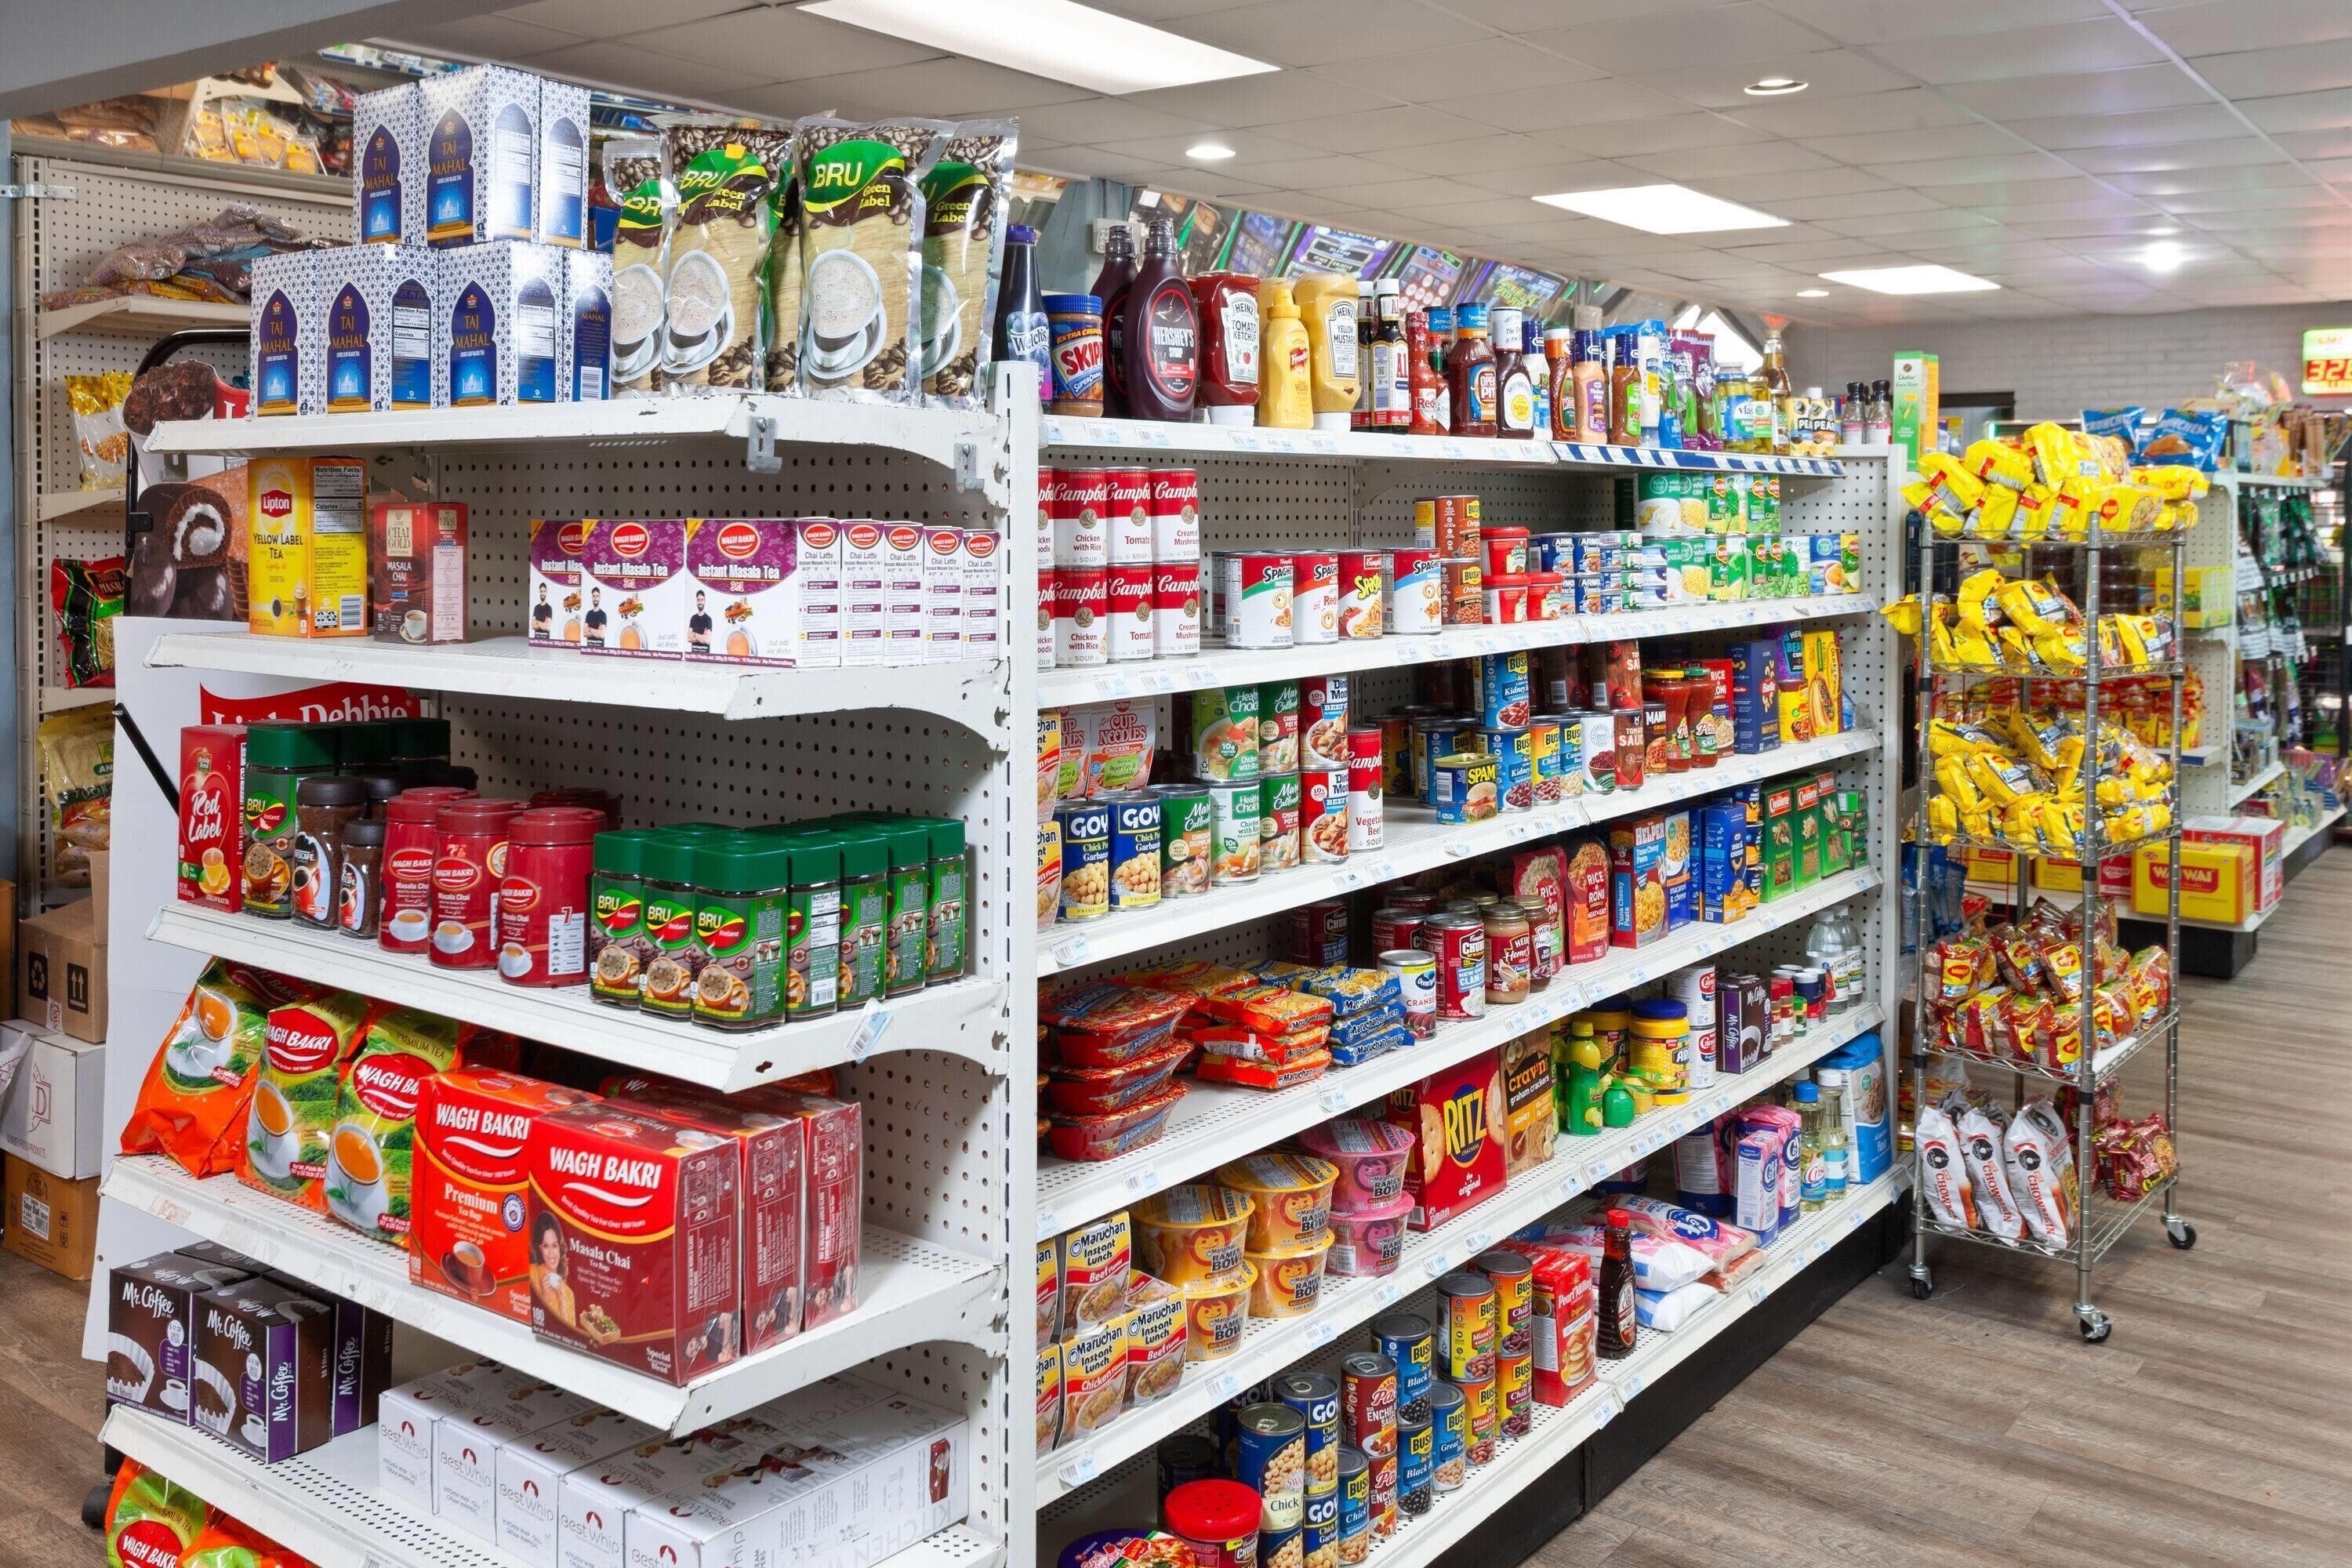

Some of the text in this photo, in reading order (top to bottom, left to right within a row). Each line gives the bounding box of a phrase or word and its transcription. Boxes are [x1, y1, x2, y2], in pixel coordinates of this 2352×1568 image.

[441, 142, 456, 156] TAJ
[372, 157, 387, 172] TAJ
[433, 158, 467, 175] MAHAL
[366, 174, 395, 191] MAHAL
[813, 162, 862, 188] BRU
[862, 183, 891, 195] Green
[858, 195, 891, 209] Label
[935, 201, 971, 212] Green
[1236, 303, 1254, 315] HEINZ
[1337, 307, 1353, 317] HEINZ
[1232, 320, 1256, 330] TOMATO
[1338, 325, 1353, 334] YELLOW
[1012, 325, 1048, 352] Welch's
[1057, 331, 1080, 343] EXTRA
[1153, 327, 1193, 348] HERSHEY'S
[1233, 330, 1256, 342] KETCHUP
[1334, 335, 1356, 344] MUSTARD
[262, 338, 292, 354] MAHAL
[1169, 348, 1182, 358] SYRUP
[263, 497, 289, 510] Lipton
[253, 533, 303, 546] YELLOW LABEL
[388, 527, 409, 539] CHAI
[388, 539, 411, 549] GOLD
[270, 548, 283, 559] TEA
[387, 561, 412, 572] MASALA
[594, 563, 667, 575] Instant Masala Tea
[699, 564, 779, 579] Instant Masala Tea
[393, 572, 406, 581] CHAI
[1711, 670, 1726, 681] RICE
[1504, 685, 1526, 695] Kidney
[1762, 681, 1775, 692] Barilla
[299, 695, 408, 722] Debbie
[1109, 714, 1137, 729] CUP
[1099, 726, 1146, 745] NOODLES
[1542, 757, 1556, 765] Chili
[1468, 764, 1496, 785] SPAM
[191, 790, 220, 816] Red
[247, 798, 266, 812] BRU
[189, 815, 222, 842] Label
[1367, 826, 1381, 835] Beef
[1635, 826, 1665, 845] HELPER
[1135, 833, 1149, 842] Chick
[1083, 843, 1096, 851] Chick
[1588, 872, 1604, 885] RICE
[2183, 869, 2212, 883] WAI
[1589, 889, 1605, 903] RONI
[699, 912, 722, 928] BRU
[1460, 975, 1479, 986] CLAM
[289, 1031, 332, 1051] BAKRI
[1133, 1021, 1172, 1050] Yakisoba
[397, 1031, 445, 1060] PREMIUM TEA
[358, 1064, 399, 1092] WAGH
[1508, 1059, 1546, 1091] crav'n
[1510, 1075, 1549, 1106] graham crackers
[437, 1103, 531, 1140] WAGH BAKRI
[1443, 1088, 1486, 1155] RITZ
[1514, 1113, 1530, 1126] HONEY
[1461, 1145, 1479, 1156] CRACKERS
[550, 1147, 662, 1189] WAGH BAKRI
[1458, 1175, 1480, 1196] original
[1981, 1164, 2013, 1222] CHOWMEIN
[445, 1183, 498, 1214] Premium
[2027, 1174, 2058, 1236] CHOWMEIN
[561, 1196, 574, 1208] Best
[575, 1206, 590, 1220] Quality
[1080, 1221, 1127, 1250] Maruchan
[570, 1238, 630, 1269] Masala Chai
[1083, 1240, 1116, 1259] Instant
[1087, 1250, 1112, 1267] Lunch
[1089, 1268, 1109, 1283] Beef
[122, 1282, 174, 1318] Mr. Coffee
[1558, 1279, 1592, 1308] Pearl Milling
[532, 1307, 544, 1321] 100
[1138, 1300, 1182, 1330] Maruchan
[1570, 1305, 1586, 1317] Original
[208, 1310, 252, 1349] Mr. Coffee
[1141, 1319, 1172, 1338] Instant
[1472, 1330, 1488, 1342] Mixed
[1076, 1326, 1123, 1356] Maruchan
[1145, 1329, 1170, 1345] Lunch
[646, 1346, 671, 1362] Special
[1081, 1346, 1113, 1366] Instant
[652, 1363, 668, 1374] Blend
[1085, 1357, 1109, 1374] Lunch
[1082, 1370, 1111, 1392] Chicken
[1407, 1374, 1427, 1388] Black
[1441, 1440, 1458, 1453] Great
[123, 1535, 147, 1560] WAGH
